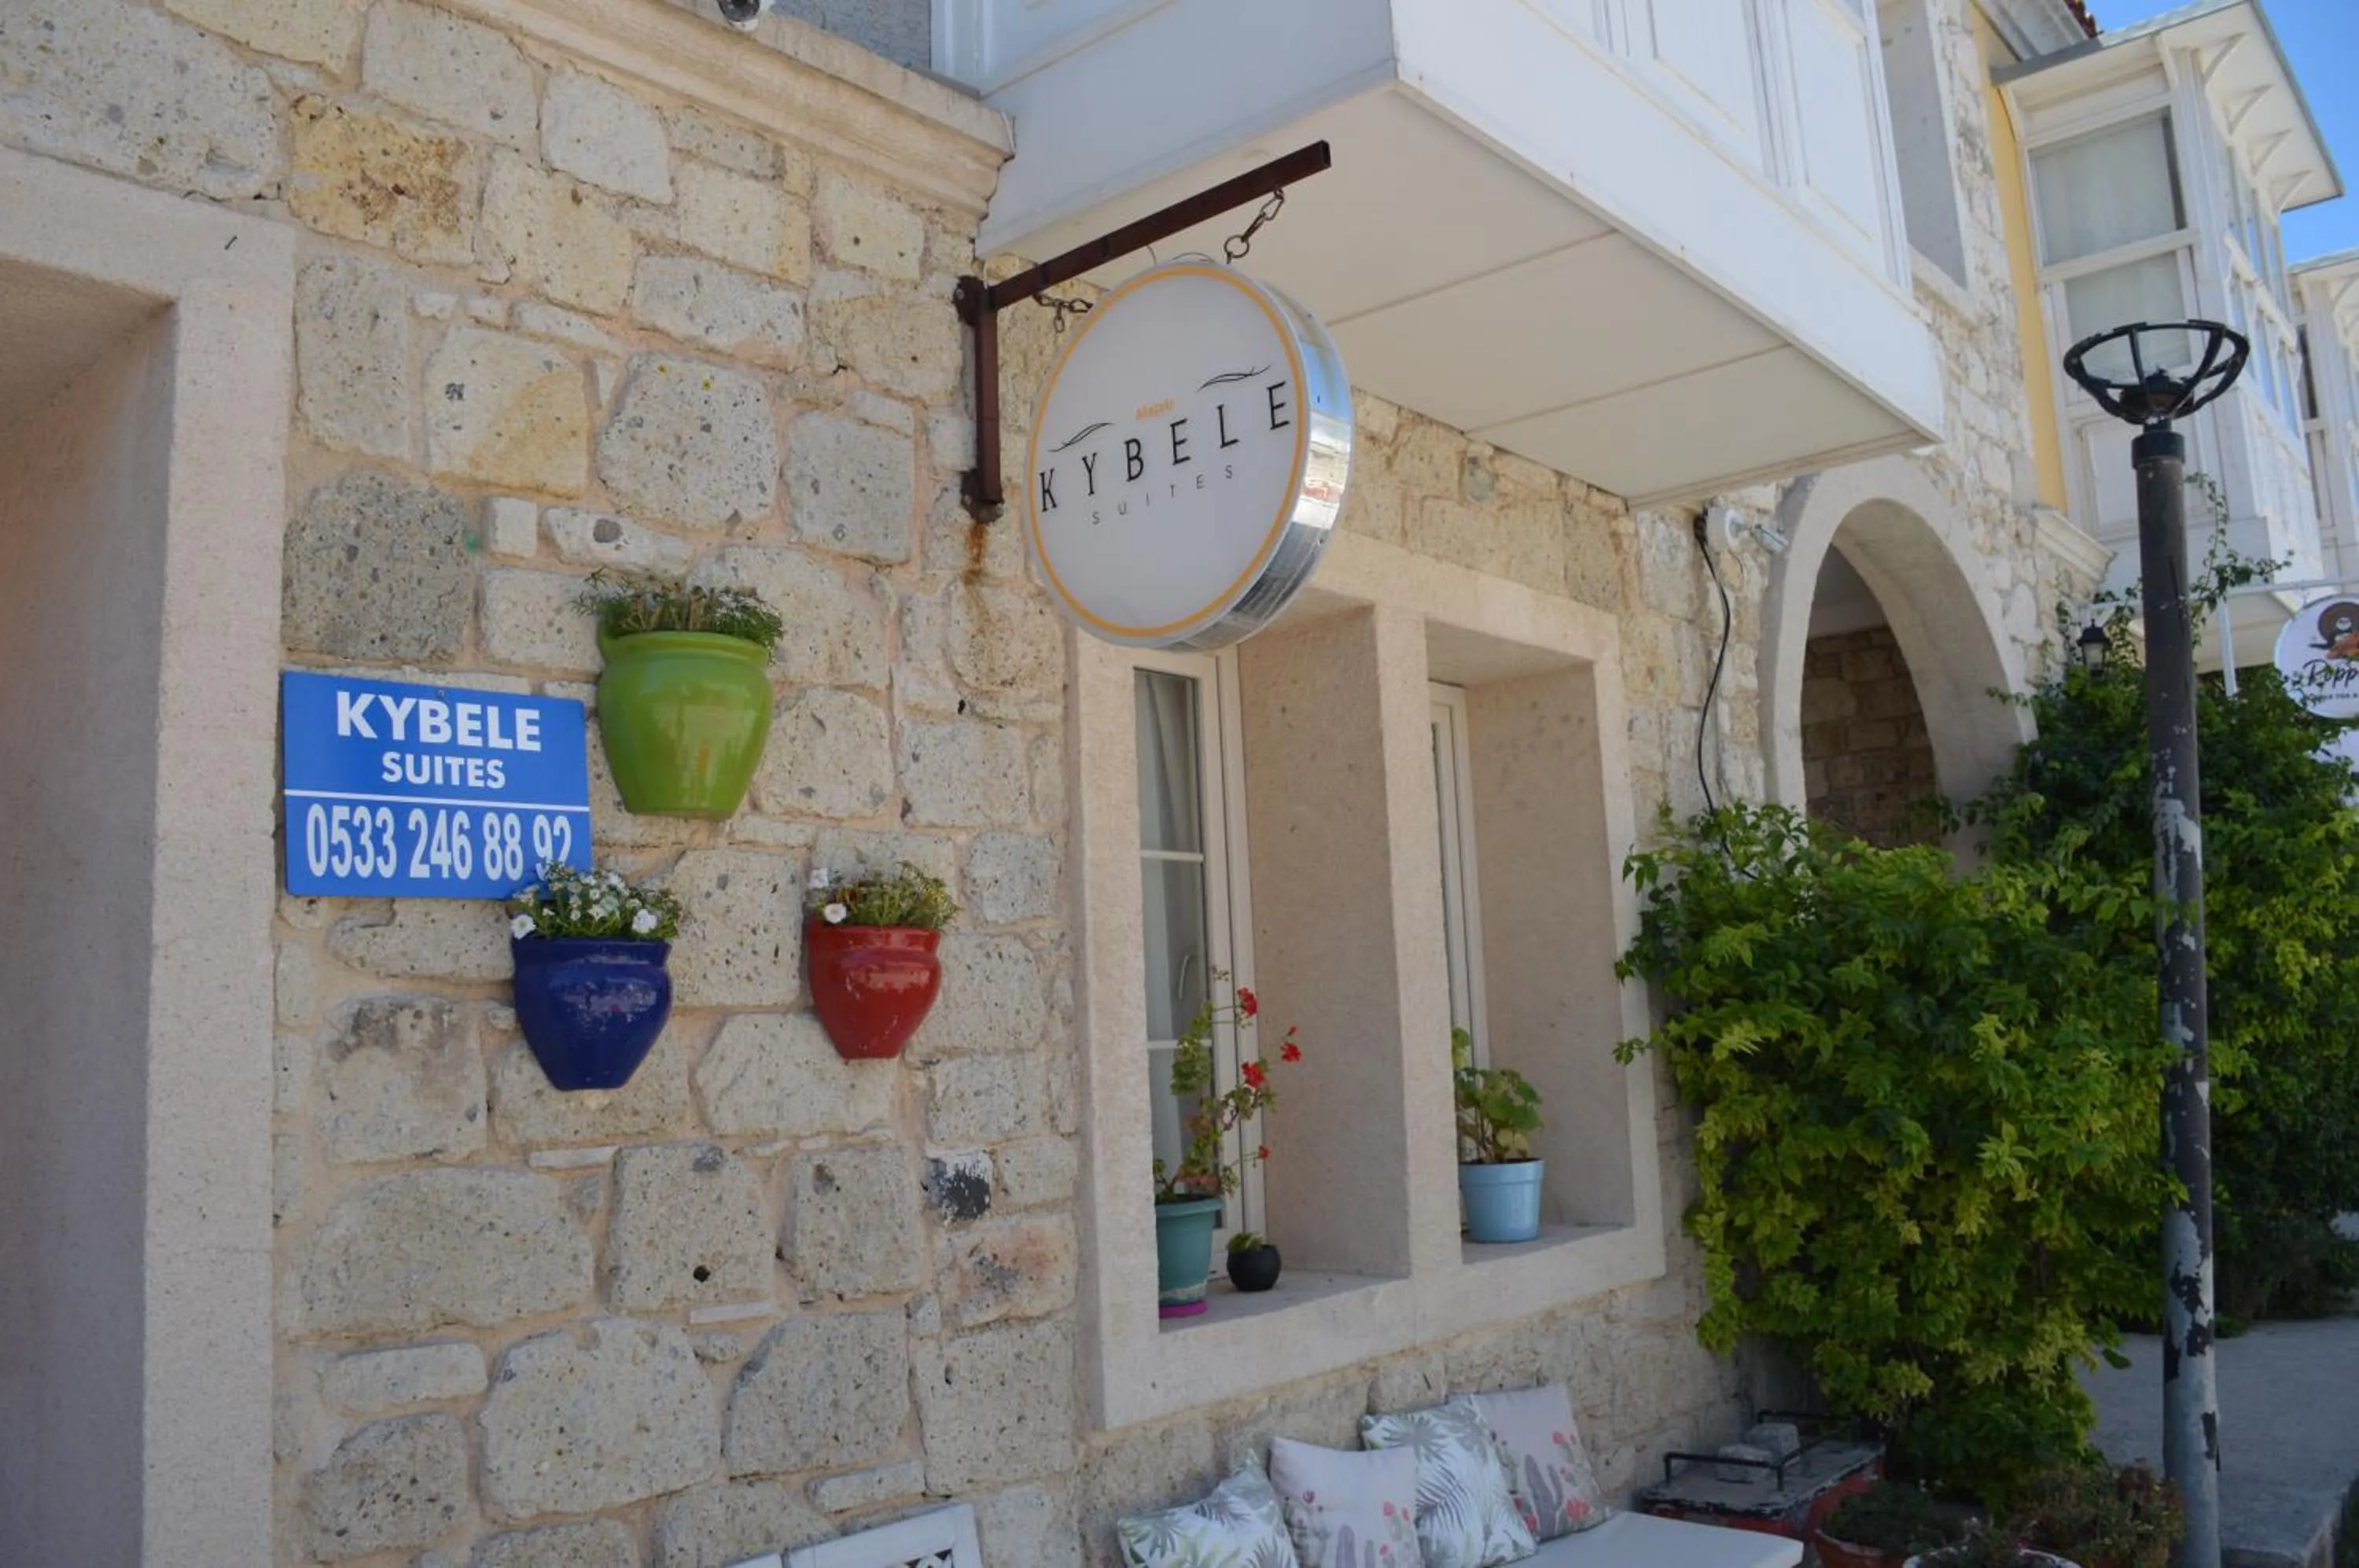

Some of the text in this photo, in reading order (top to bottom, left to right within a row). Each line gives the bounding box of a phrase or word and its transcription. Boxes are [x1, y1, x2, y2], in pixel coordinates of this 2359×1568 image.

[1040, 381, 1290, 513] KYBELE
[1092, 465, 1234, 525] SUITES
[337, 690, 542, 752] KYBELE
[381, 751, 506, 789] SUITES
[306, 803, 397, 878] 0533
[408, 808, 472, 880] 246
[482, 812, 524, 882] 88
